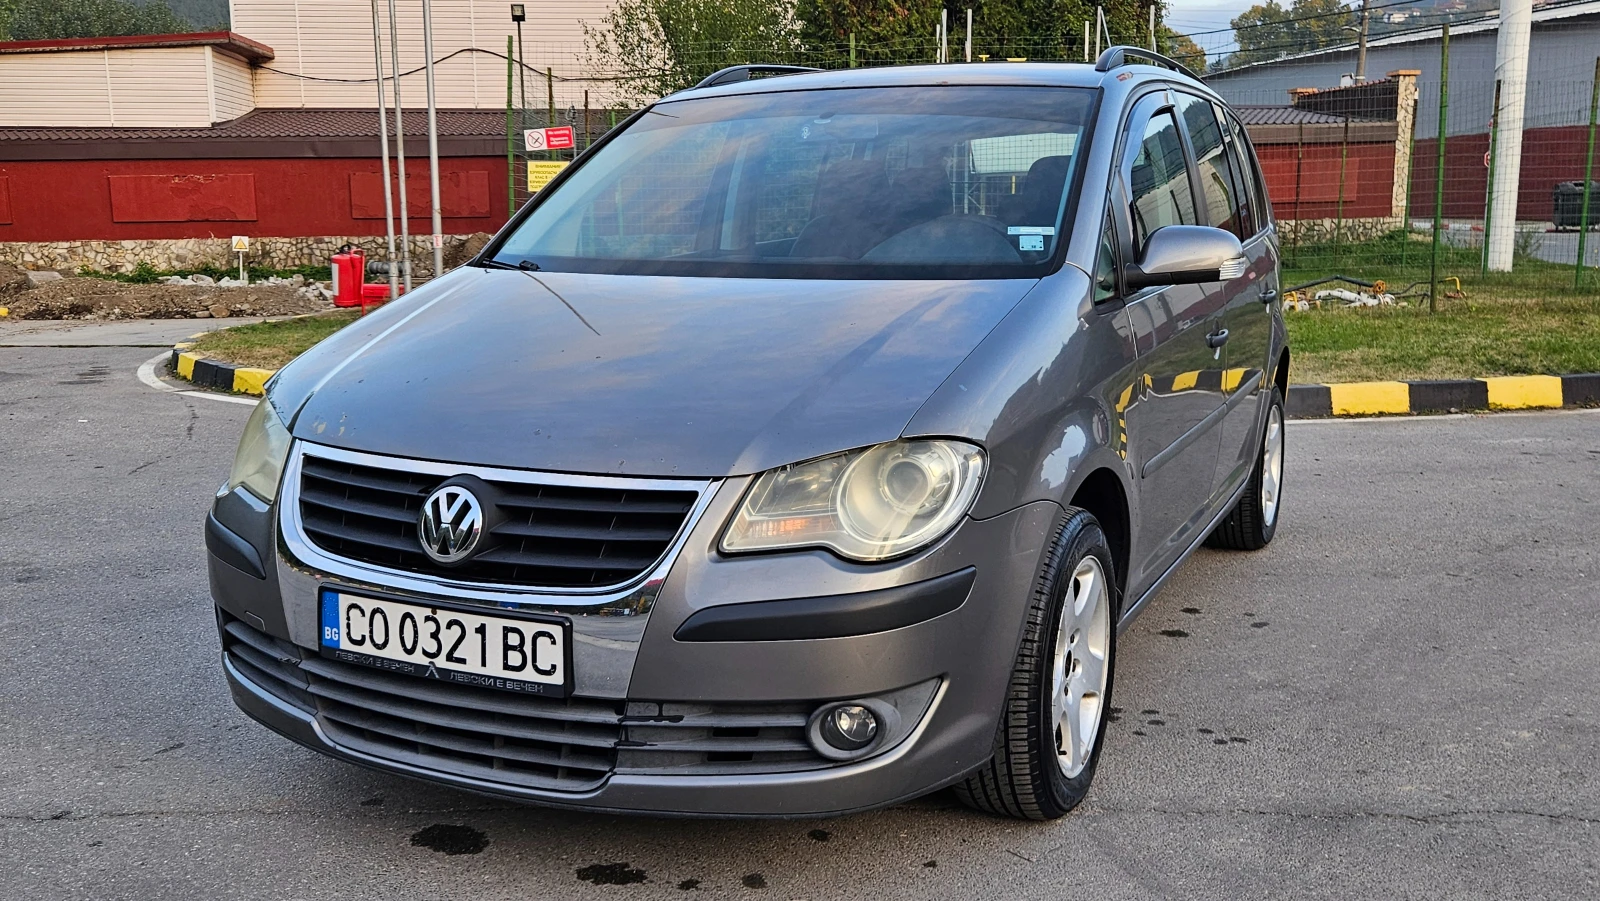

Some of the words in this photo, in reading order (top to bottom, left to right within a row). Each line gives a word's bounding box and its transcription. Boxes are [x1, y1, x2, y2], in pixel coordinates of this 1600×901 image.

[324, 626, 339, 641] BG
[346, 602, 390, 651] CO
[399, 611, 487, 668] 0321
[502, 625, 557, 677] BC
[335, 650, 374, 666] ЛЕВСКИ
[450, 671, 494, 687] ЛЕВСКИ
[506, 681, 543, 693] ВЕЧЕН
